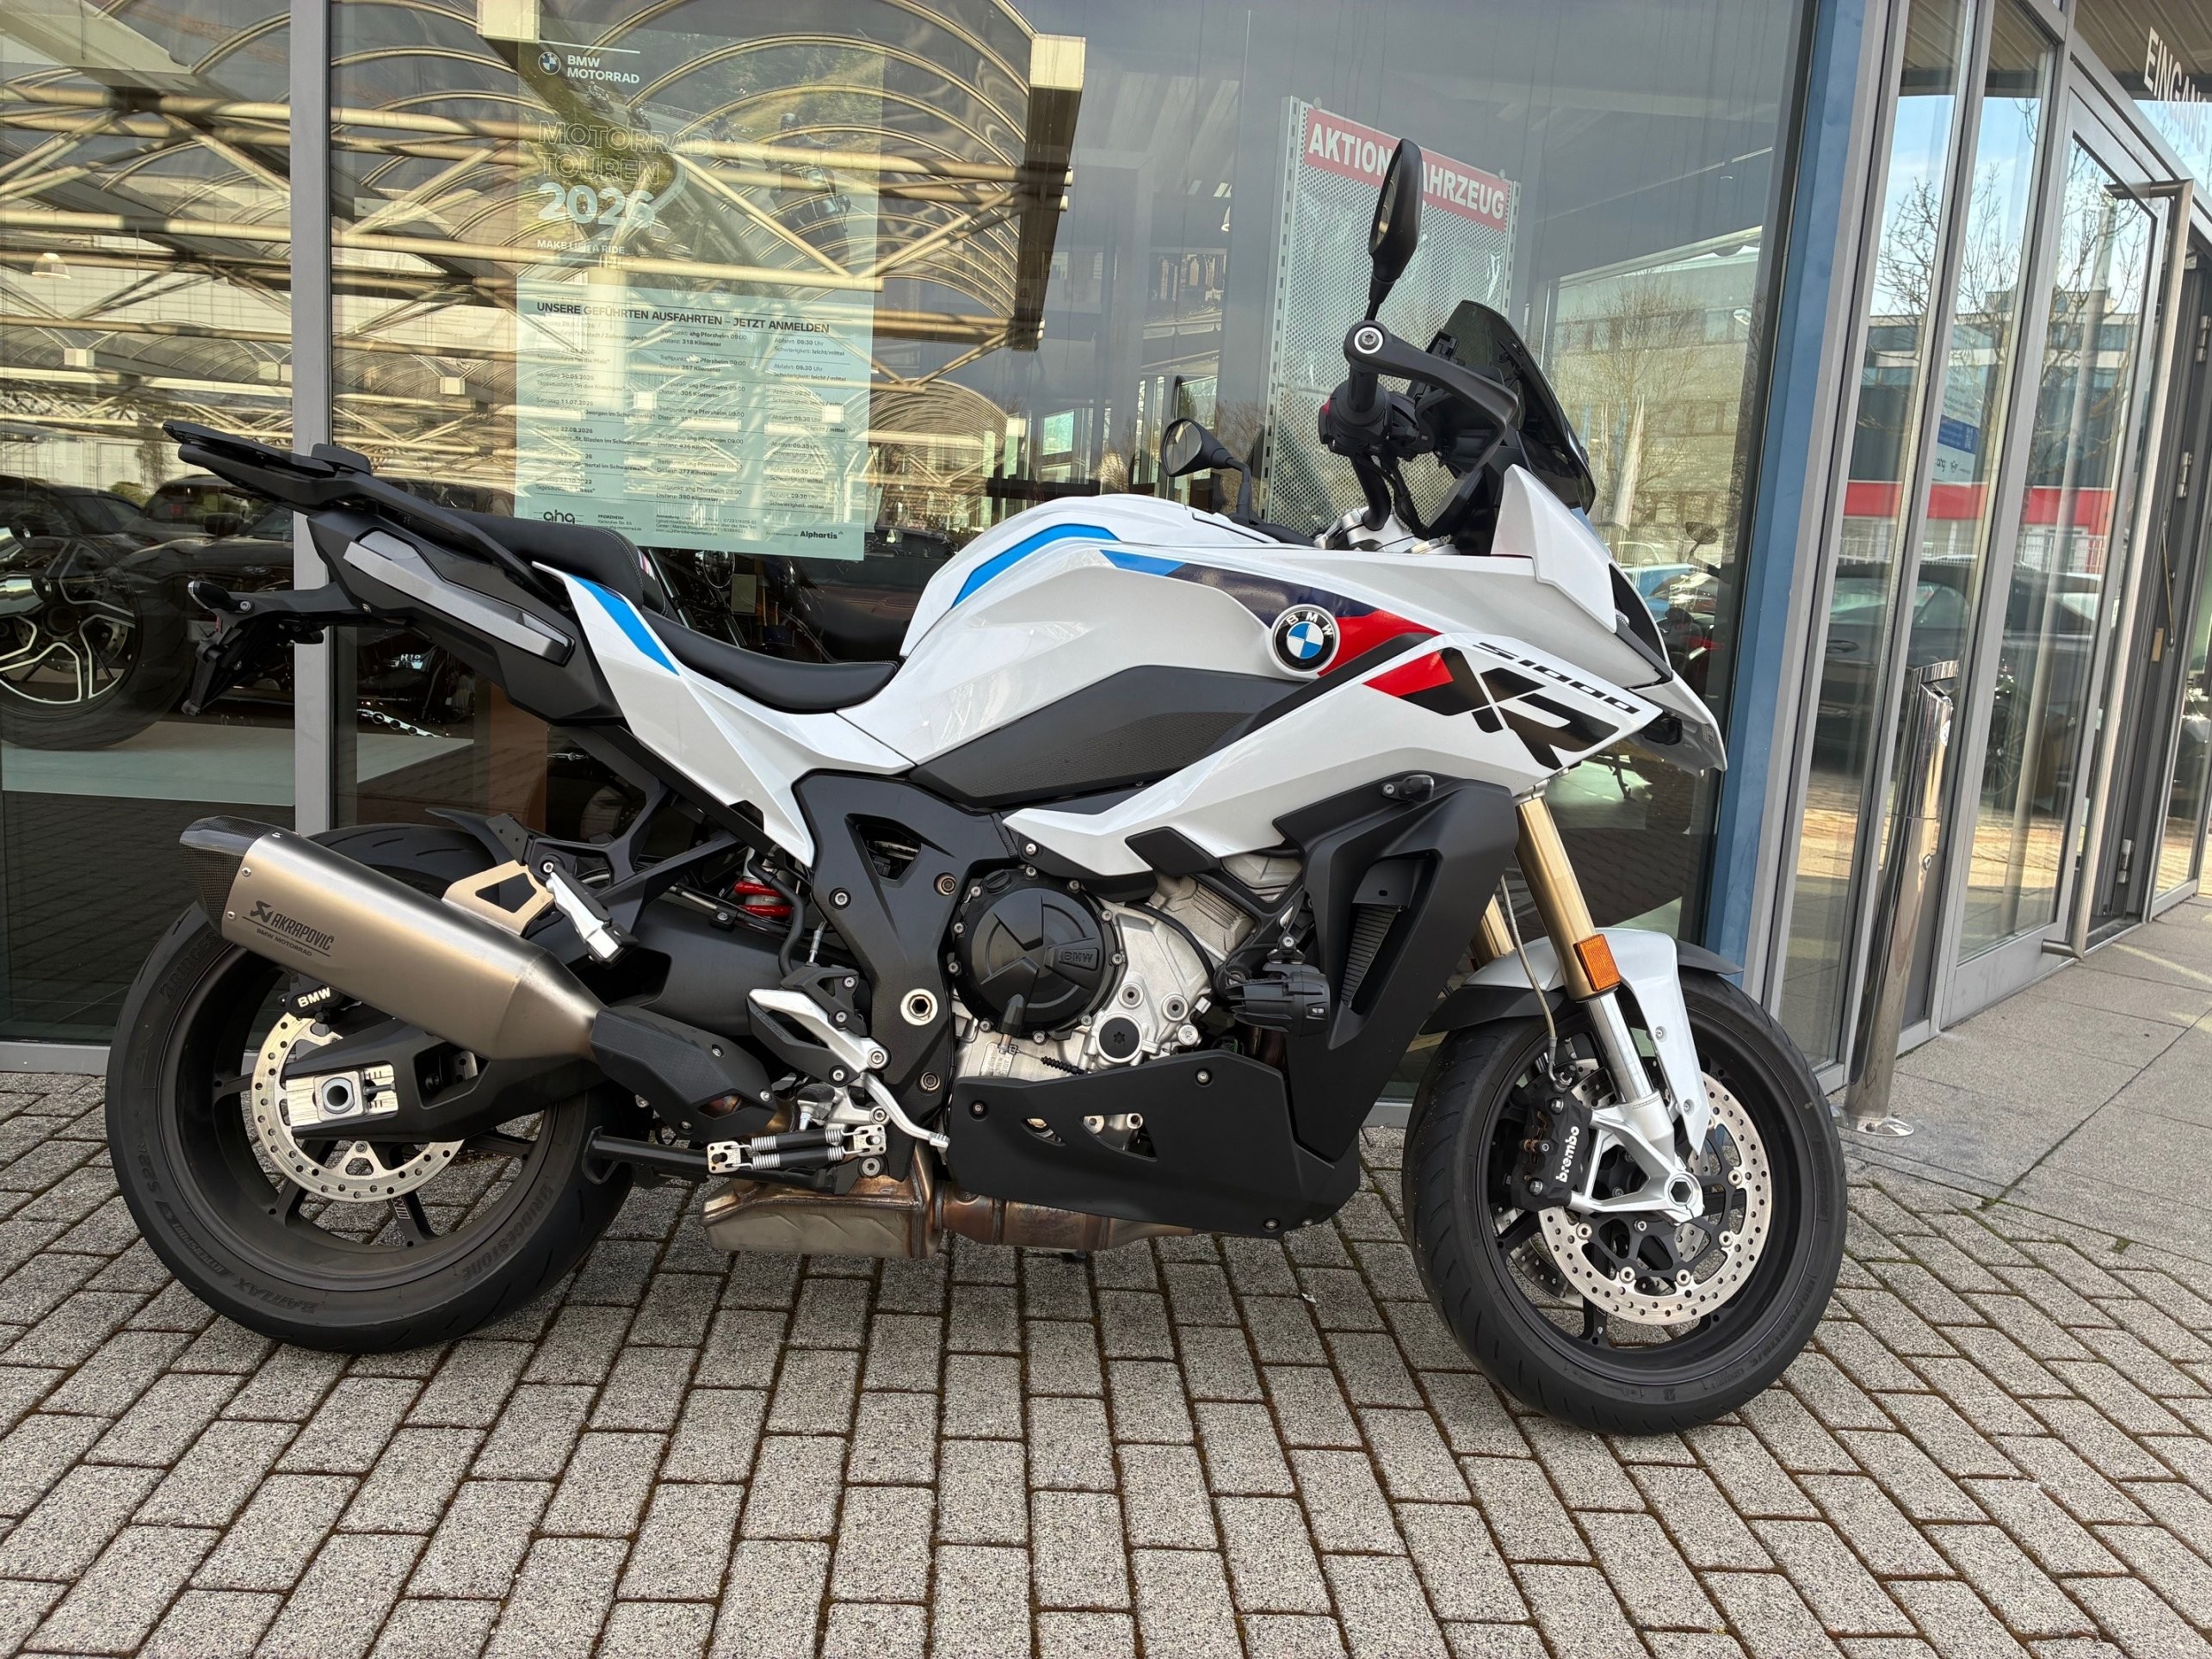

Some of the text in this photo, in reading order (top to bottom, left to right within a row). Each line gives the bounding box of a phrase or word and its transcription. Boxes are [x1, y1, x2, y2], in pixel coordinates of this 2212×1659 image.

[567, 55, 601, 67] BMW
[567, 67, 640, 84] MOTORRAD
[538, 121, 713, 157] MOTORRAD
[538, 152, 659, 185] TOUREN
[538, 182, 655, 229] 2026
[537, 239, 566, 250] MAKE
[602, 245, 625, 255] RIDE
[537, 301, 581, 315] UNSERE
[584, 305, 649, 320] GEFÜHRTEN
[652, 312, 723, 325] AUSFAHRTEN
[733, 317, 766, 329] JETZT
[769, 320, 830, 333] ANMELDEN
[543, 510, 575, 524] ahg
[800, 530, 837, 540] Alphartis
[1286, 611, 1333, 638] BMW
[1473, 641, 1640, 715] S1000
[256, 928, 312, 956] BMW MOTORRAD
[1063, 950, 1094, 963] BMW
[297, 987, 331, 1008] BMW
[1555, 1125, 1580, 1183] brembo
